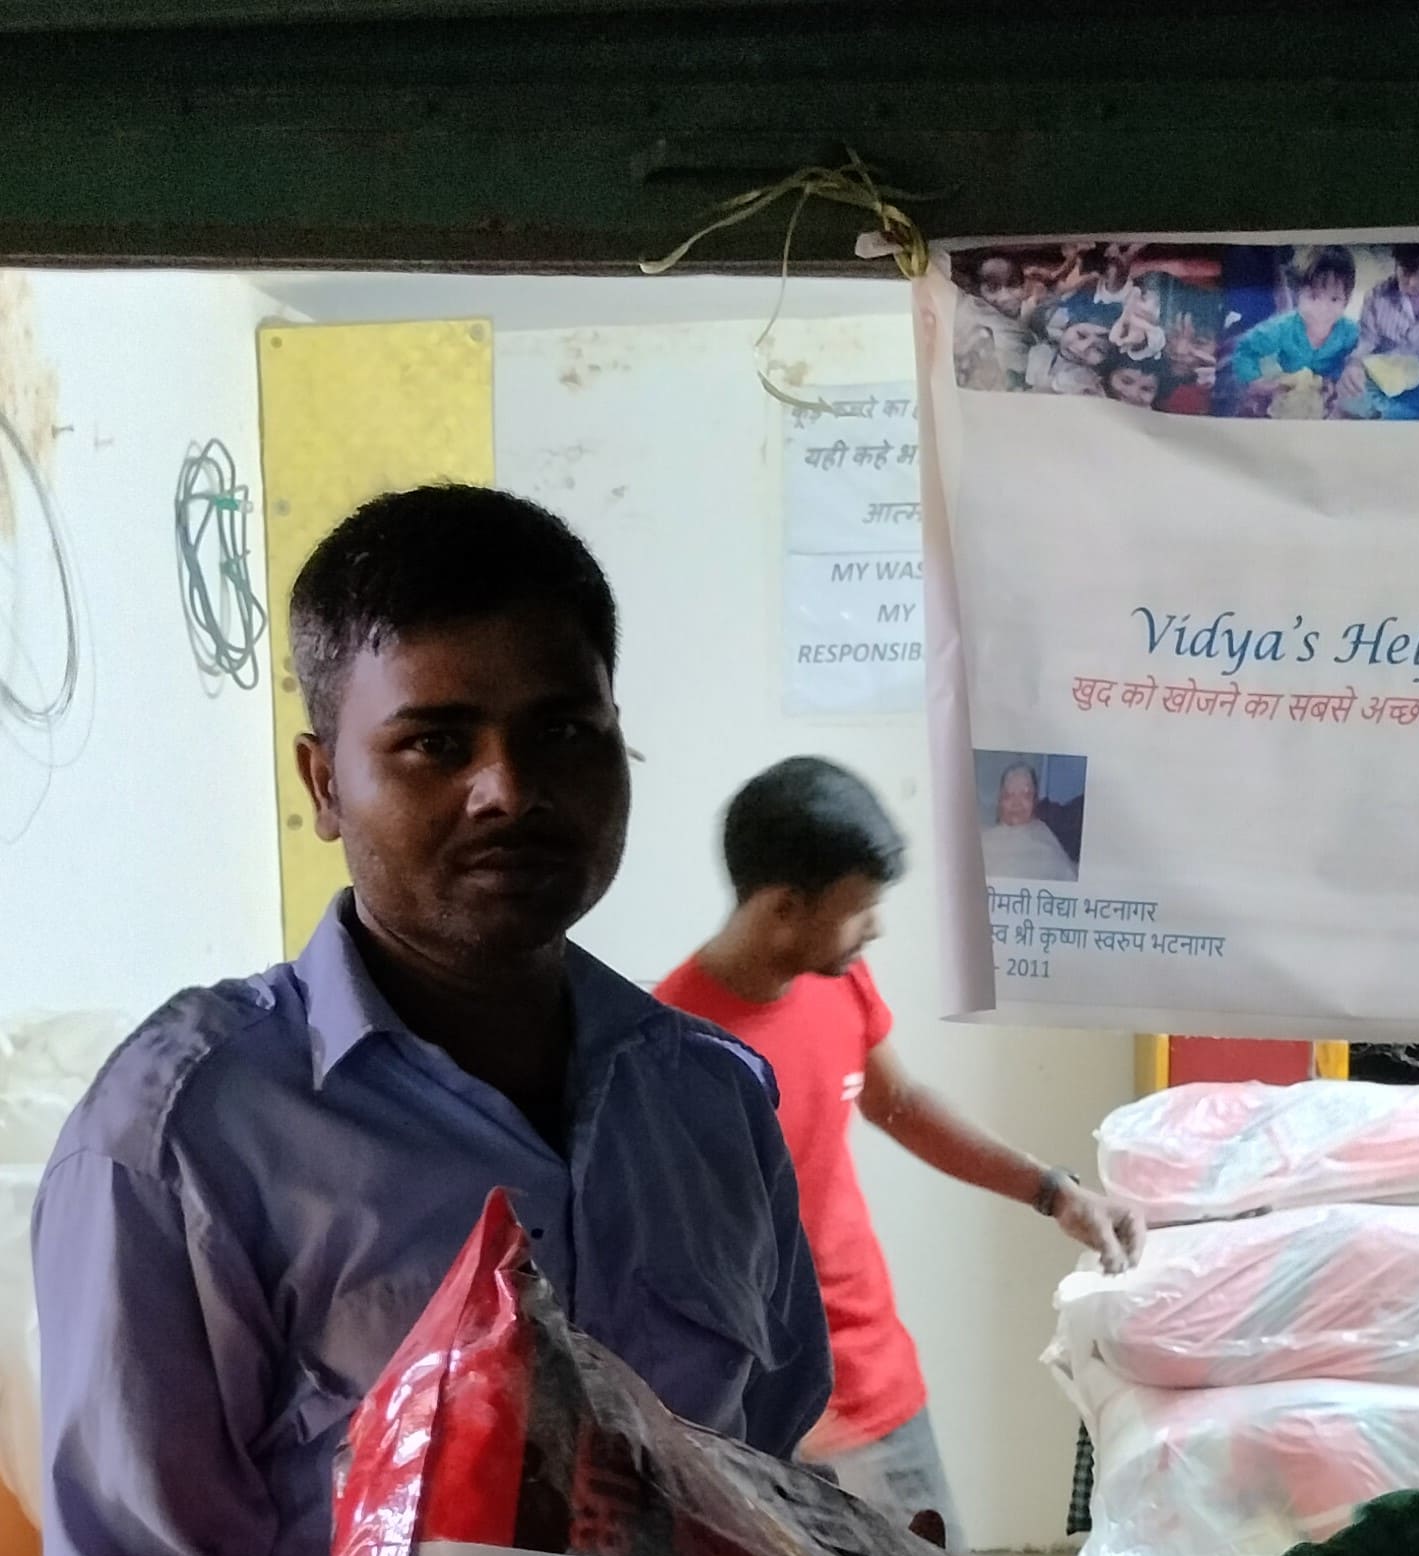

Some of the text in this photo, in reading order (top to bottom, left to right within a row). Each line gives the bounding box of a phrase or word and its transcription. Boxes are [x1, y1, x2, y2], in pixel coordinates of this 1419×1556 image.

[804, 440, 849, 471] यही
[852, 439, 894, 470] कहे
[831, 562, 869, 582] MY
[877, 603, 916, 623] MY
[1071, 675, 1118, 713] खुद
[1120, 674, 1158, 711] को
[1161, 677, 1241, 717] खोजने
[1244, 691, 1286, 721] का
[1287, 685, 1359, 723] सबसे
[1037, 888, 1079, 919] विद्या
[1084, 898, 1159, 922] भटनागर
[1015, 918, 1034, 947] श्री
[1039, 925, 1089, 954] कृष्णा
[1151, 933, 1227, 958] भटनागर
[1007, 957, 1050, 979] 2011
